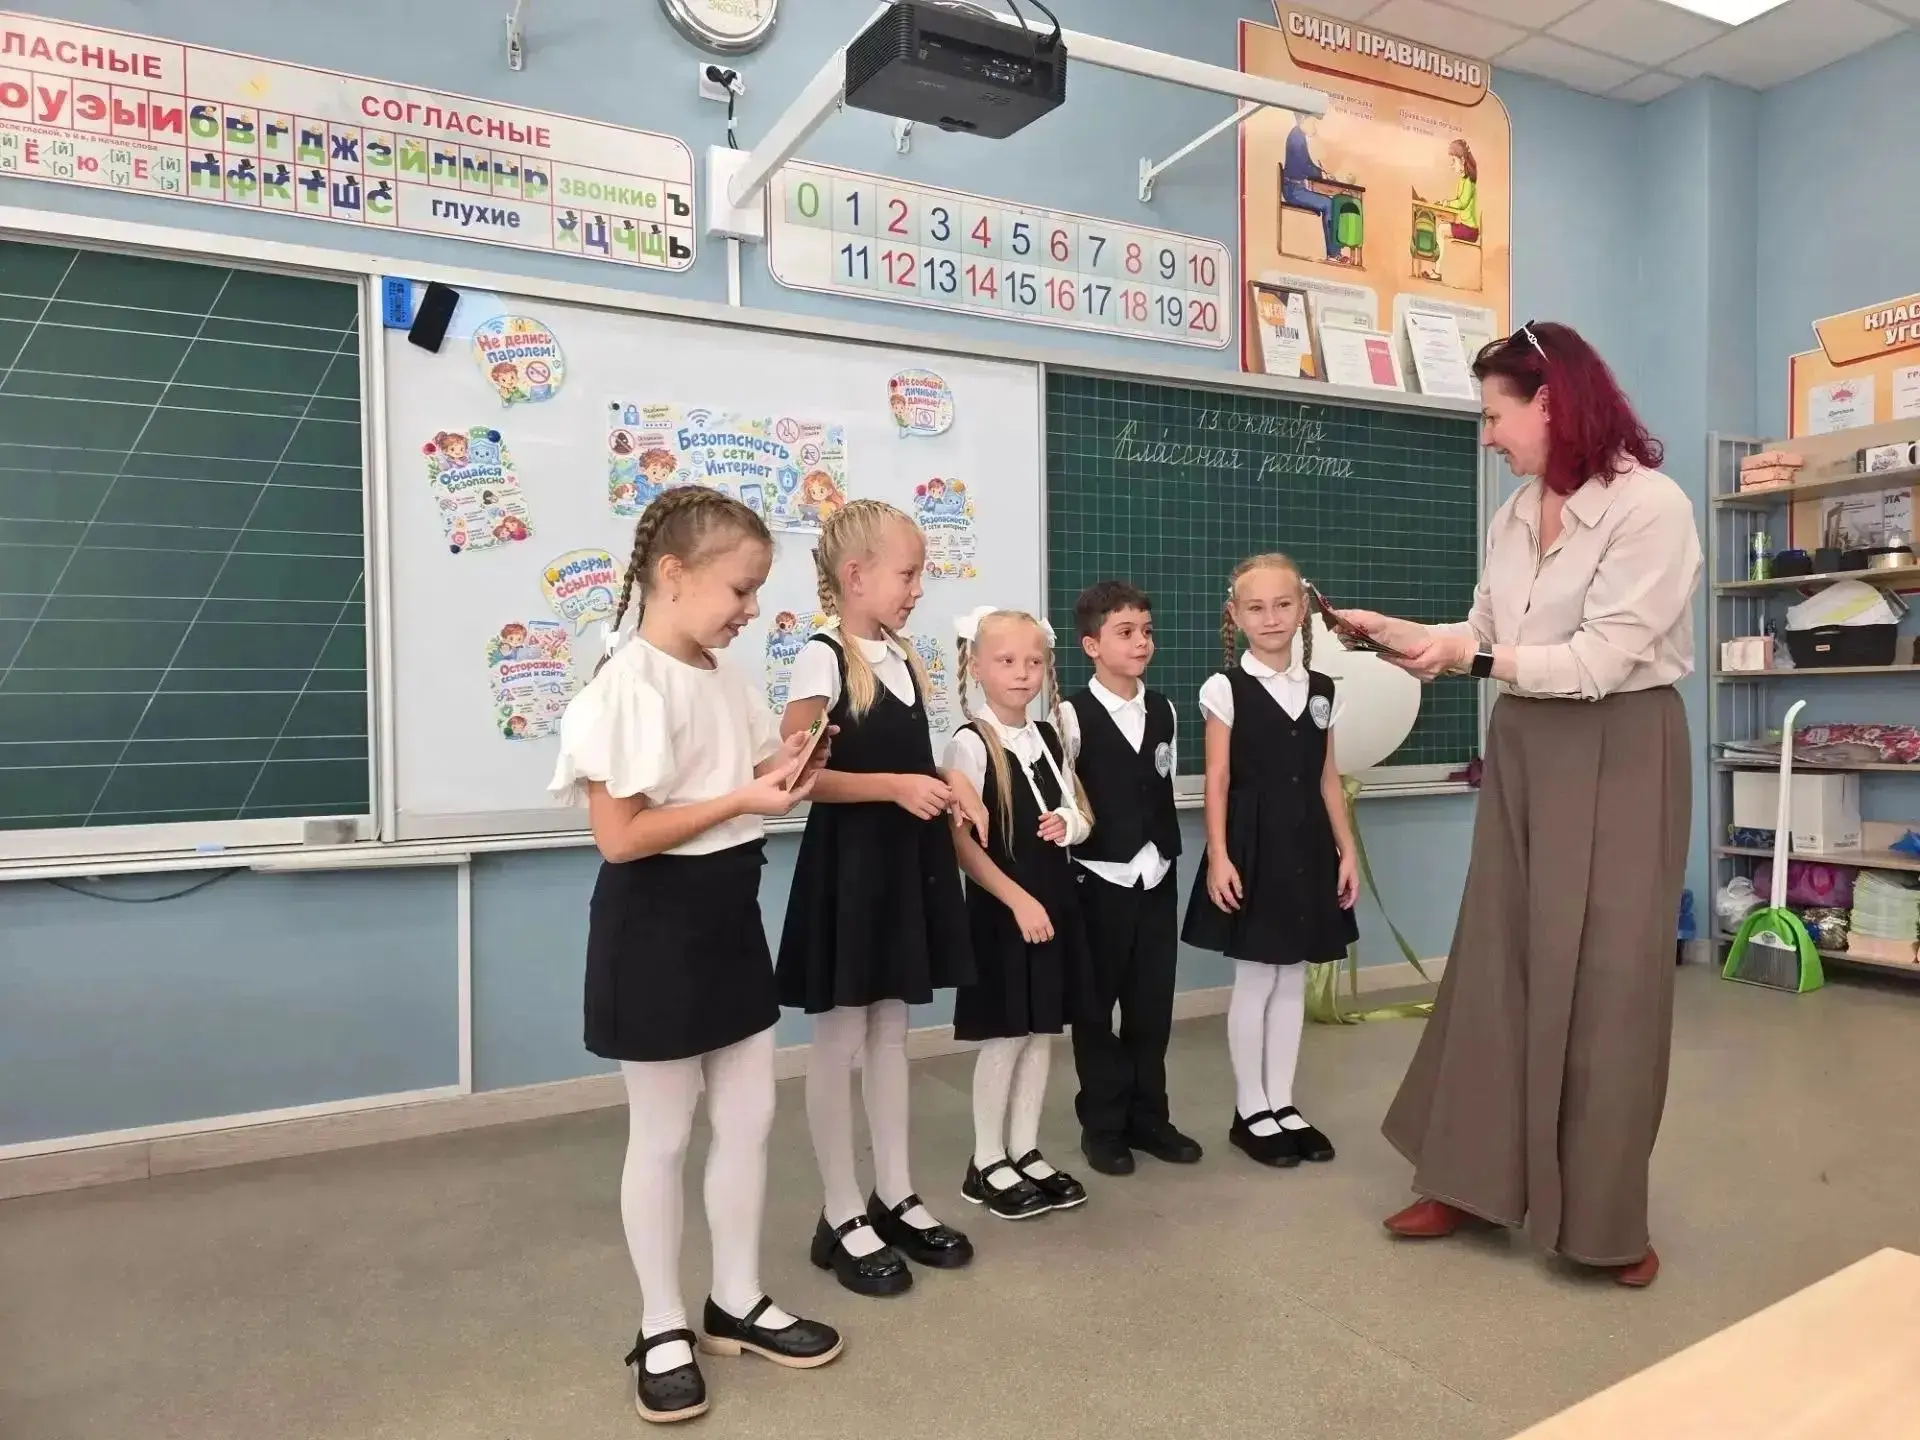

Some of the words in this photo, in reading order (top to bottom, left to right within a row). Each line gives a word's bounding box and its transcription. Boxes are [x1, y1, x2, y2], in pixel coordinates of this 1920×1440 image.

[2, 31, 163, 79] ЛАСНЫЕ
[1288, 11, 1351, 51] СИДИ
[1357, 30, 1482, 87] ПРАВИЛЬНО
[361, 95, 551, 149] СОГЛАСНЫЕ
[559, 178, 657, 208] звонкие
[432, 199, 521, 229] глухие
[798, 182, 819, 218] 0
[846, 191, 860, 226] 1
[888, 199, 908, 234] 2
[931, 207, 950, 241] 3
[971, 216, 991, 249] 4
[1012, 223, 1030, 255] 5
[1050, 230, 1069, 262] 6
[1089, 236, 1106, 268] 7
[1125, 243, 1142, 274] 8
[1159, 249, 1176, 280] 9
[1189, 255, 1215, 287] 10
[841, 244, 869, 279] 11
[882, 251, 916, 287] 12
[924, 257, 957, 293] 13
[966, 265, 998, 299] 14
[1005, 271, 1037, 305] 15
[1045, 278, 1075, 311] 16
[1083, 284, 1111, 316] 17
[1120, 289, 1147, 322] 18
[1155, 296, 1183, 327] 19
[1188, 301, 1217, 332] 20
[477, 335, 501, 351] Не
[505, 333, 552, 348] делись
[486, 345, 555, 363] паролем!
[1199, 409, 1219, 430] 13
[677, 428, 789, 459] Безопасность
[707, 448, 716, 459] в
[723, 448, 755, 460] сети
[440, 465, 502, 485] Общайся
[705, 460, 772, 478] Интернет
[447, 477, 505, 493] безопасно
[556, 570, 617, 598] ссылки!
